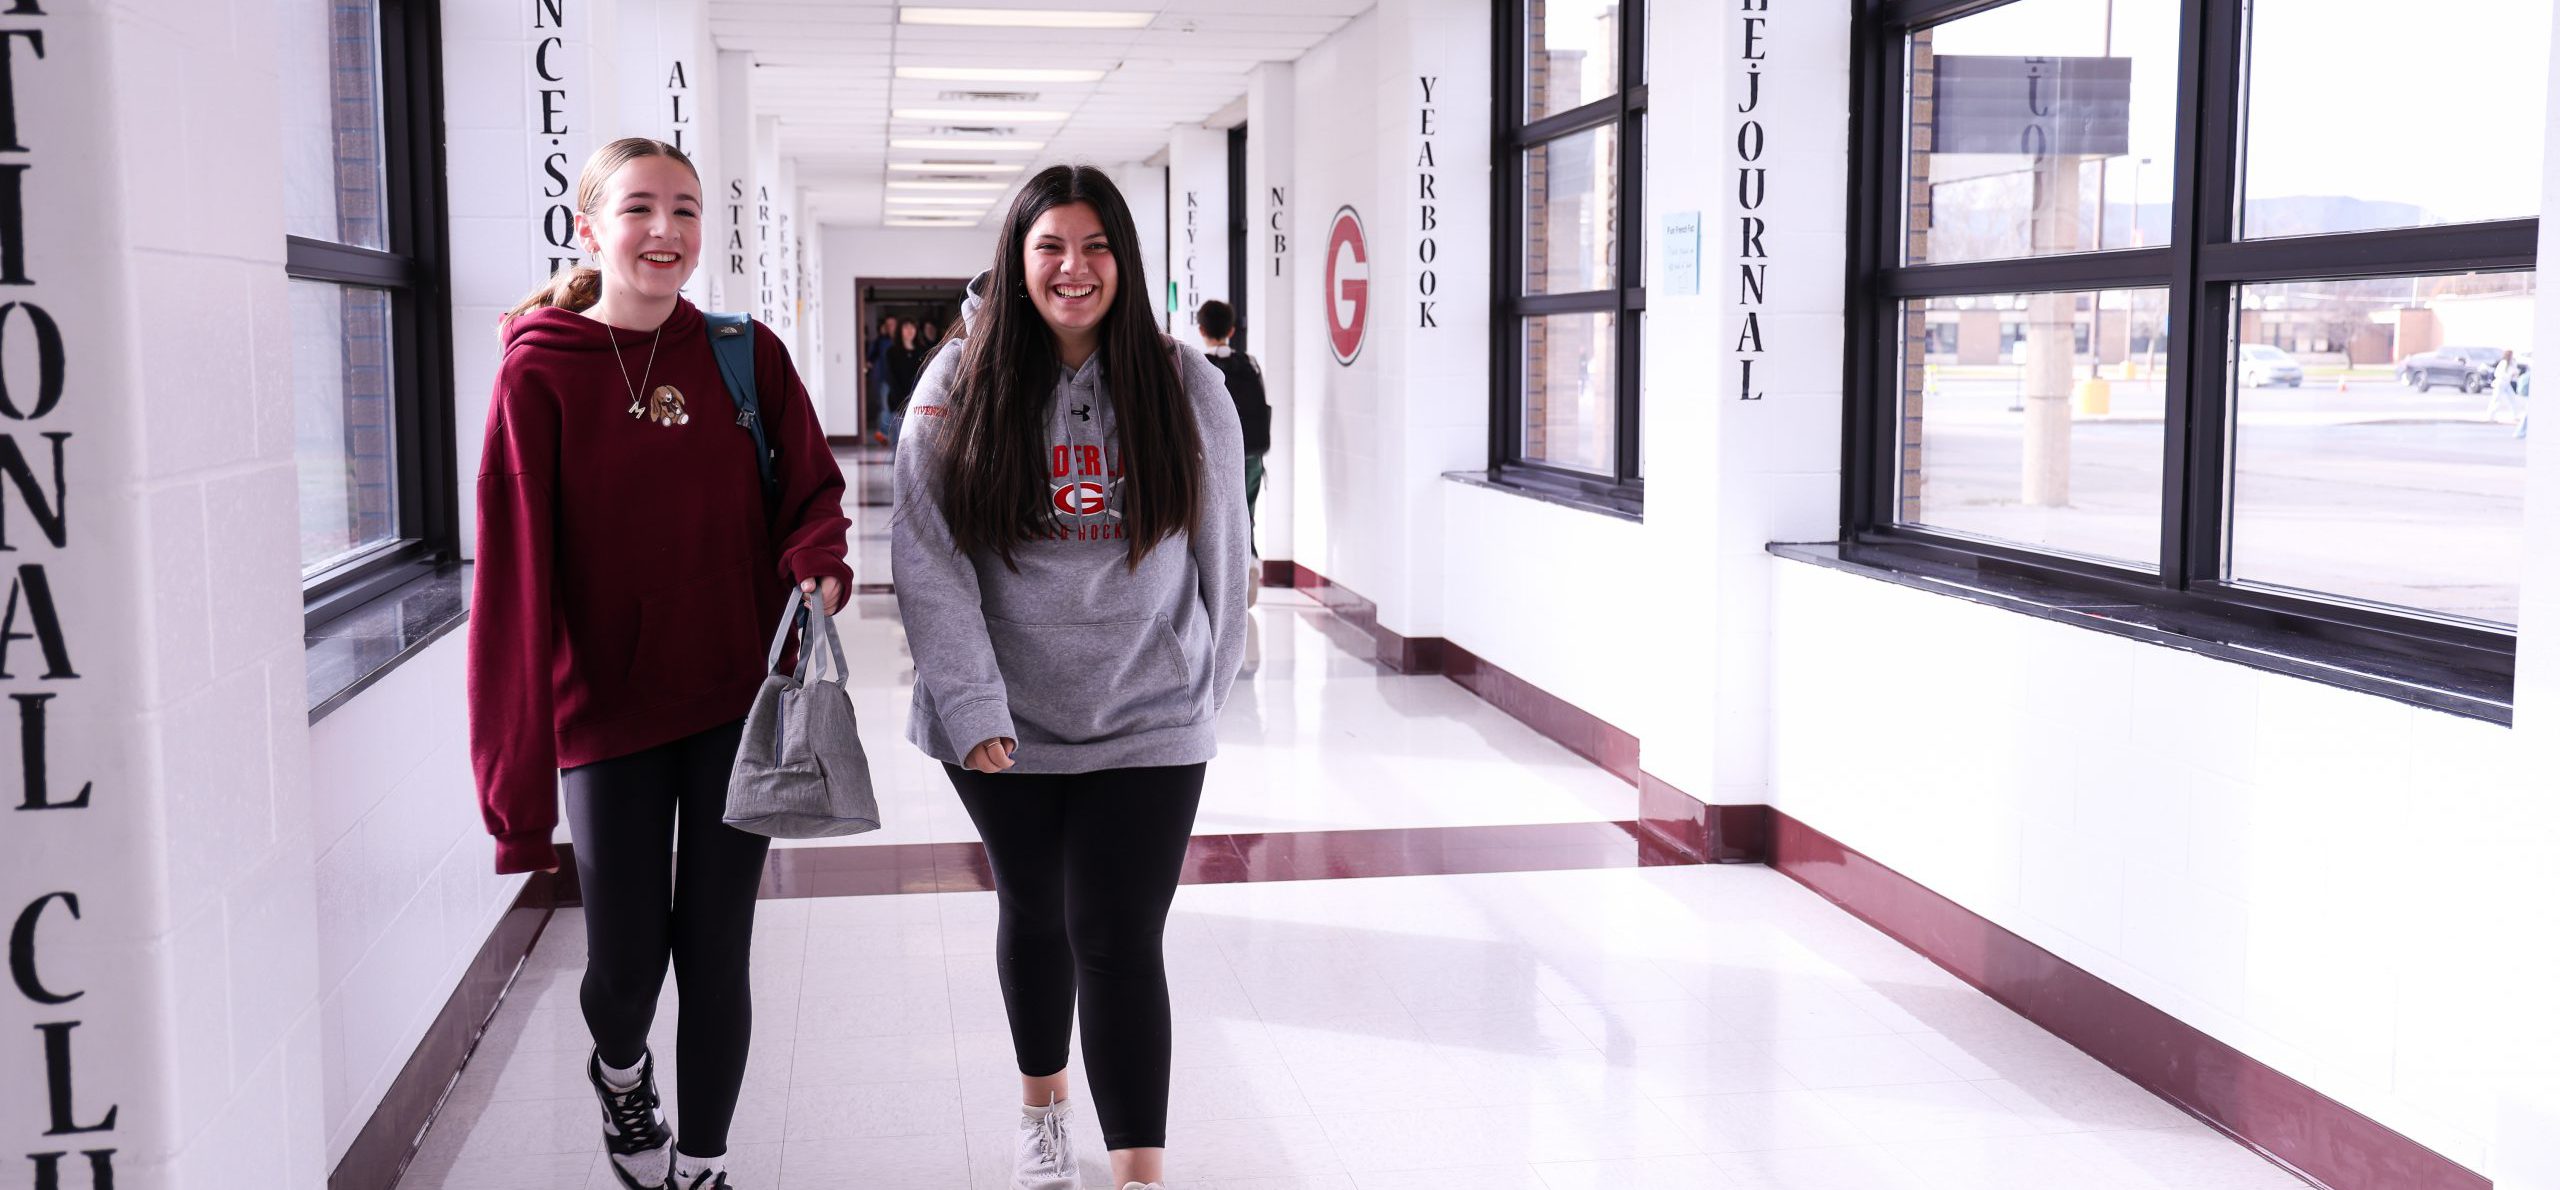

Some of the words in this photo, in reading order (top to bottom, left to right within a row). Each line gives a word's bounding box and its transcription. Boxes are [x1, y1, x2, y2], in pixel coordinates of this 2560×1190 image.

[728, 179, 744, 275] STAR
[1271, 187, 1286, 277] NCBI
[1418, 76, 1438, 328] YEARBOOK
[1325, 214, 1368, 358] G
[0, 0, 92, 811] TIONAL
[1053, 482, 1111, 515] G
